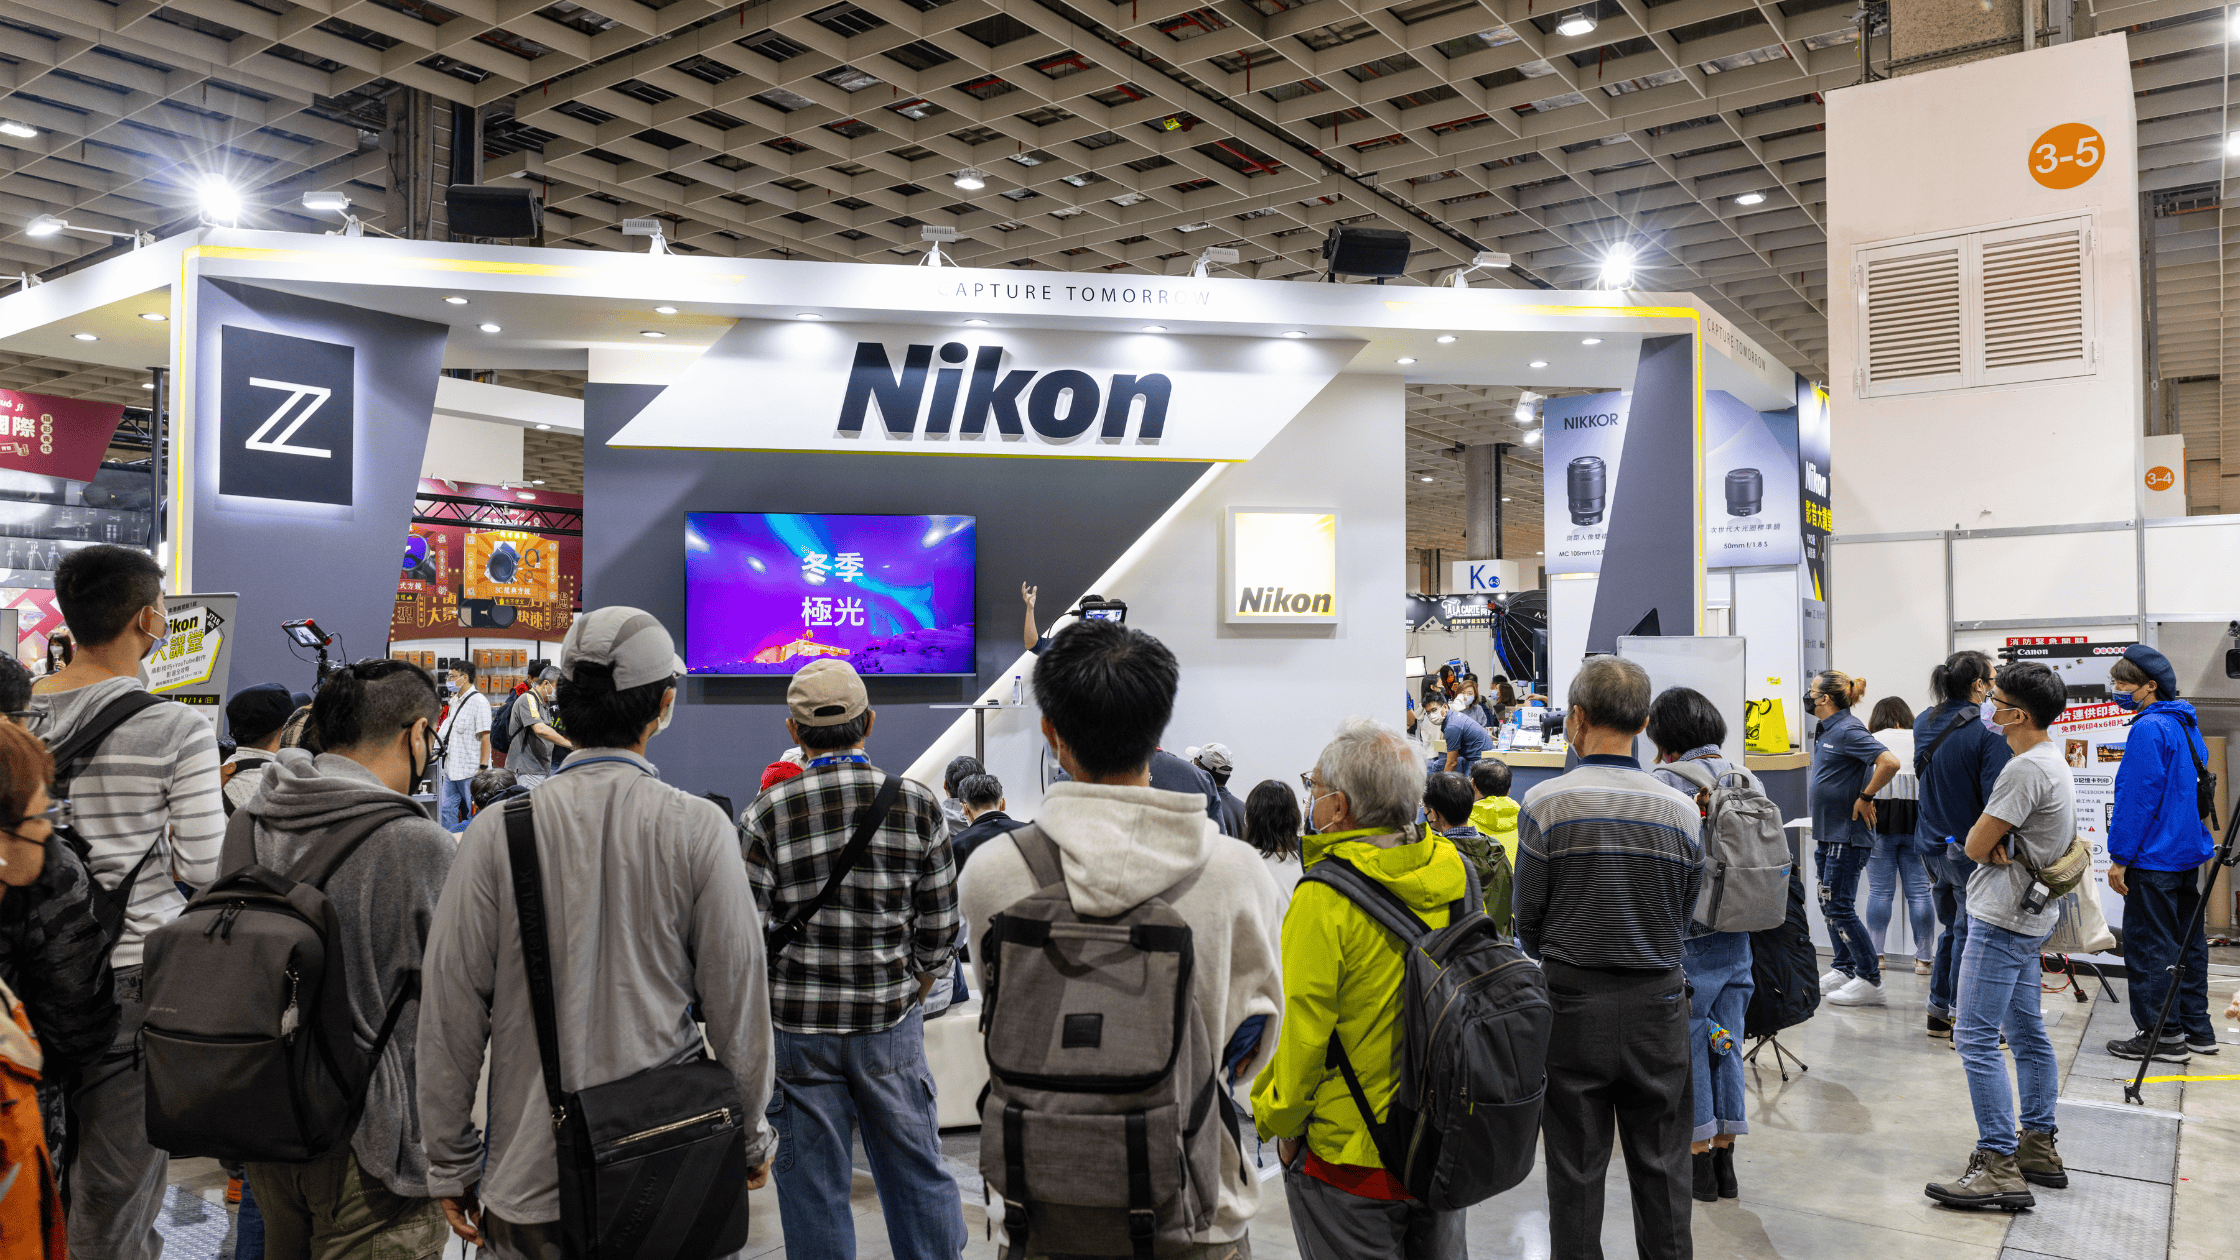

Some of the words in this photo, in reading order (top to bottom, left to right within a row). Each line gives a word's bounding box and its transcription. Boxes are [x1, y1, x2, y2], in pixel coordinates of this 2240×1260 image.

[2035, 135, 2099, 173] 3-5
[938, 281, 1051, 300] CAPTURE
[1066, 286, 1210, 305] TOMORROW
[837, 342, 1173, 444] Nikon
[245, 376, 332, 459] Z
[1564, 413, 1619, 430] NIKKOR
[1805, 461, 1827, 498] Nikon
[2147, 472, 2173, 485] 3-4
[801, 551, 864, 582] 冬季
[1470, 565, 1487, 589] K
[801, 596, 865, 626] 極光
[1238, 587, 1332, 613] Nikon
[169, 616, 199, 635] ikon
